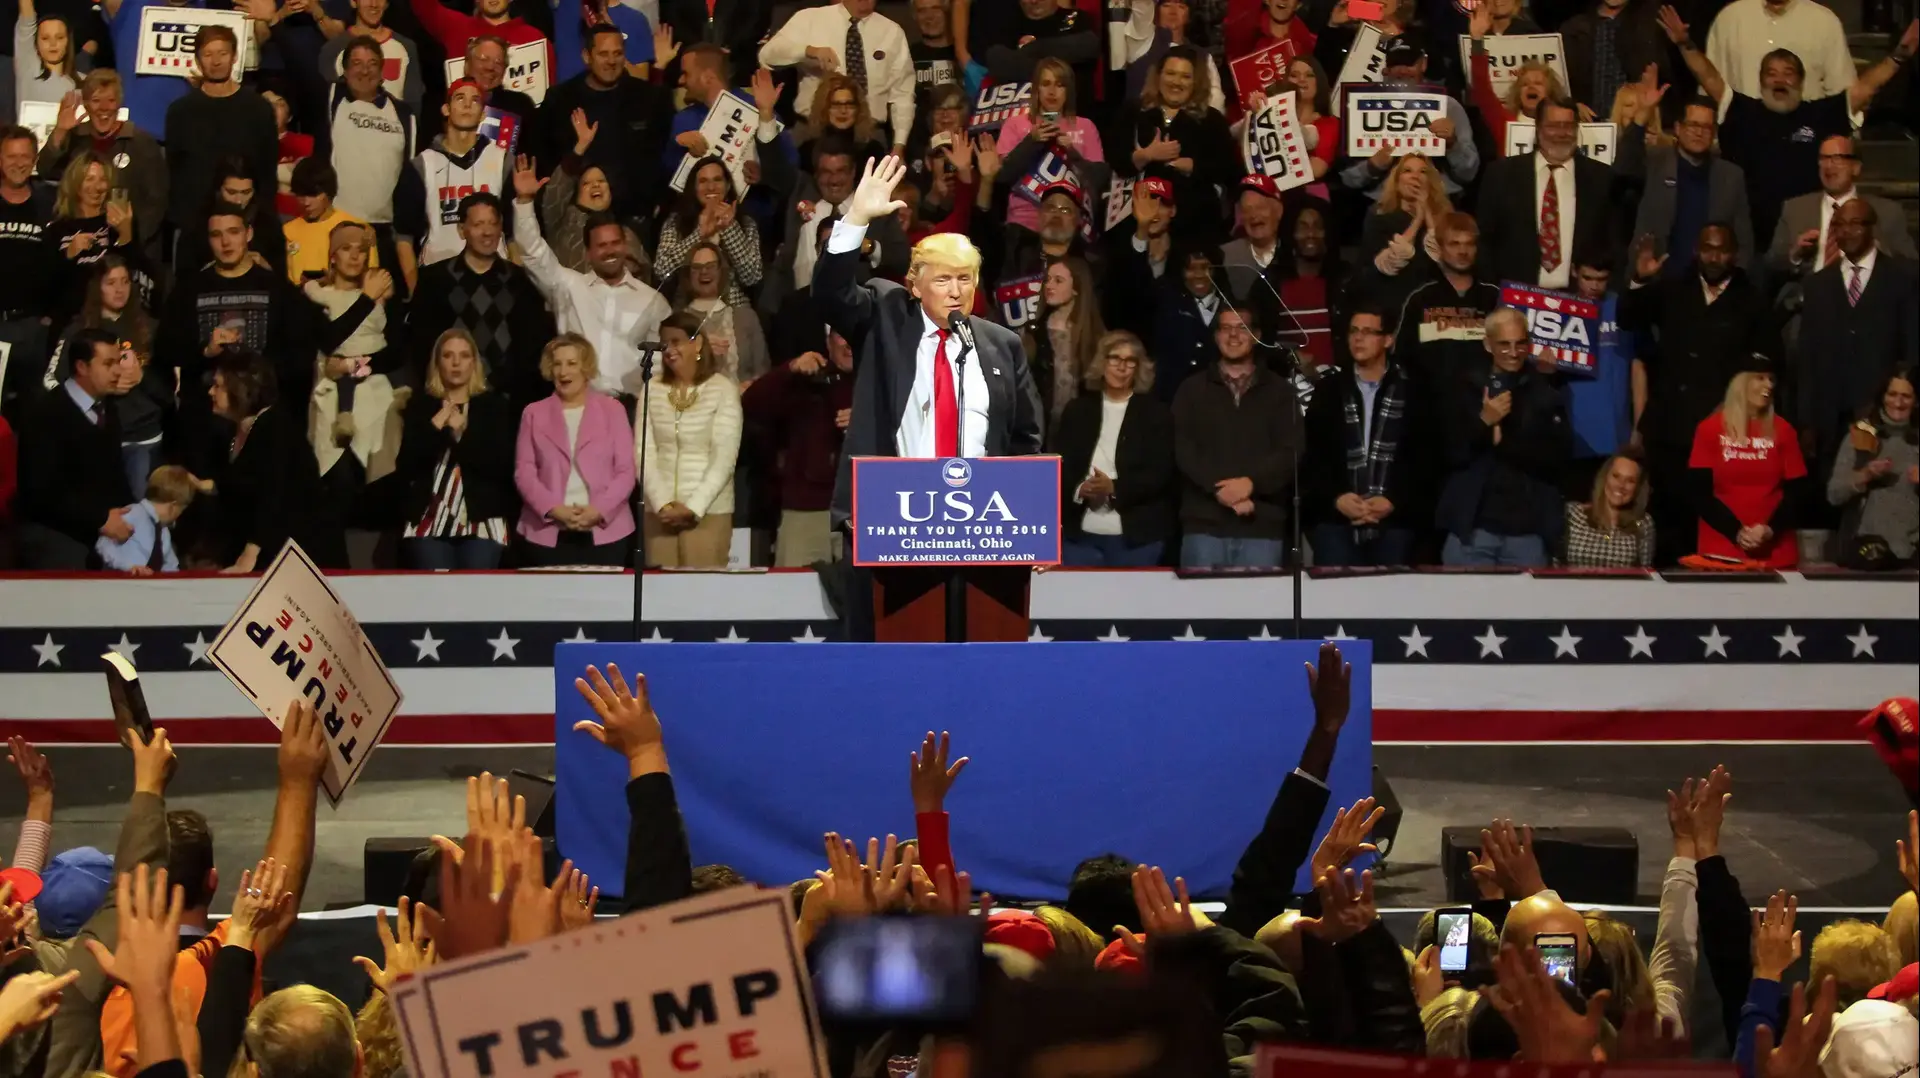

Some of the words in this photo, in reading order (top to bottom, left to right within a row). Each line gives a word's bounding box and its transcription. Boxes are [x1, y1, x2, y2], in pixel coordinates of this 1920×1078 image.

[155, 33, 196, 53] US
[1469, 53, 1556, 67] RUMP
[977, 82, 1032, 109] USA
[712, 107, 744, 158] UMP
[1362, 111, 1432, 132] USA
[1257, 106, 1288, 179] USA
[1147, 181, 1166, 192] SA
[0, 222, 42, 234] RUMP
[1003, 295, 1041, 327] US
[1751, 436, 1774, 449] WON
[896, 491, 1018, 522] USA
[867, 526, 918, 536] THANK
[926, 526, 956, 535] YOU
[964, 526, 1003, 535] TOUR
[1012, 525, 1047, 535] 2016
[900, 538, 976, 550] Cincinnati,
[979, 538, 1013, 549] Ohio
[878, 554, 909, 562] MAKE
[911, 554, 961, 562] AMERICA
[963, 553, 998, 561] GREAT
[1001, 553, 1036, 561] AGAIN
[310, 624, 333, 653] GREAT
[275, 608, 364, 729] PENCE
[332, 653, 358, 690] AMERICA
[246, 620, 358, 765] TRUMP
[356, 690, 373, 716] MAKE
[458, 969, 780, 1078] TRUMP
[553, 1029, 762, 1078] NCE
